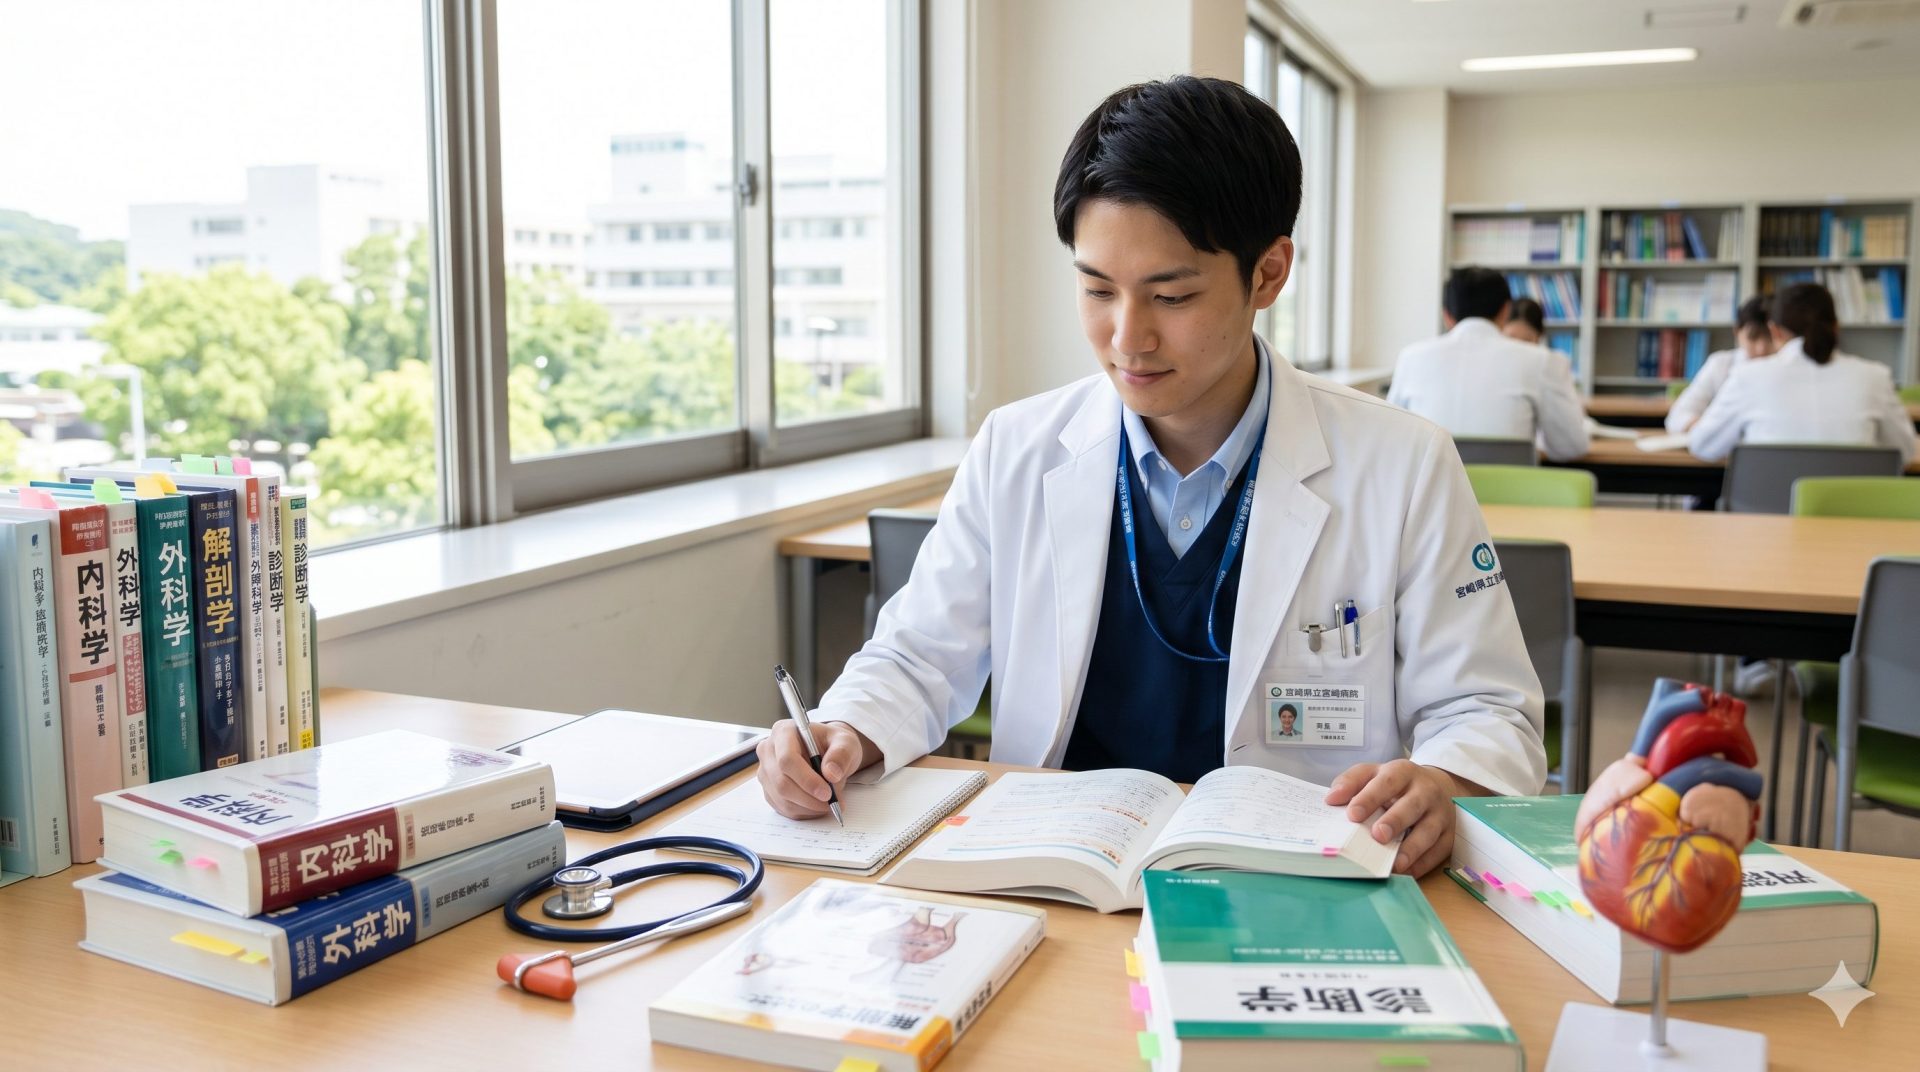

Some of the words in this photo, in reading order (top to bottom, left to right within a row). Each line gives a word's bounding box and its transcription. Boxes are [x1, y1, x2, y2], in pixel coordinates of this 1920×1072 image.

[117, 547, 141, 627] 外科学
[158, 540, 191, 647] 外科学
[202, 527, 235, 635] 解剖学
[268, 550, 284, 612] 診断学
[293, 543, 309, 603] 診断学
[77, 560, 109, 666] 内科学
[296, 825, 393, 884] 内科学
[322, 899, 411, 965] 外科学
[1236, 985, 1432, 1014] 診断学
